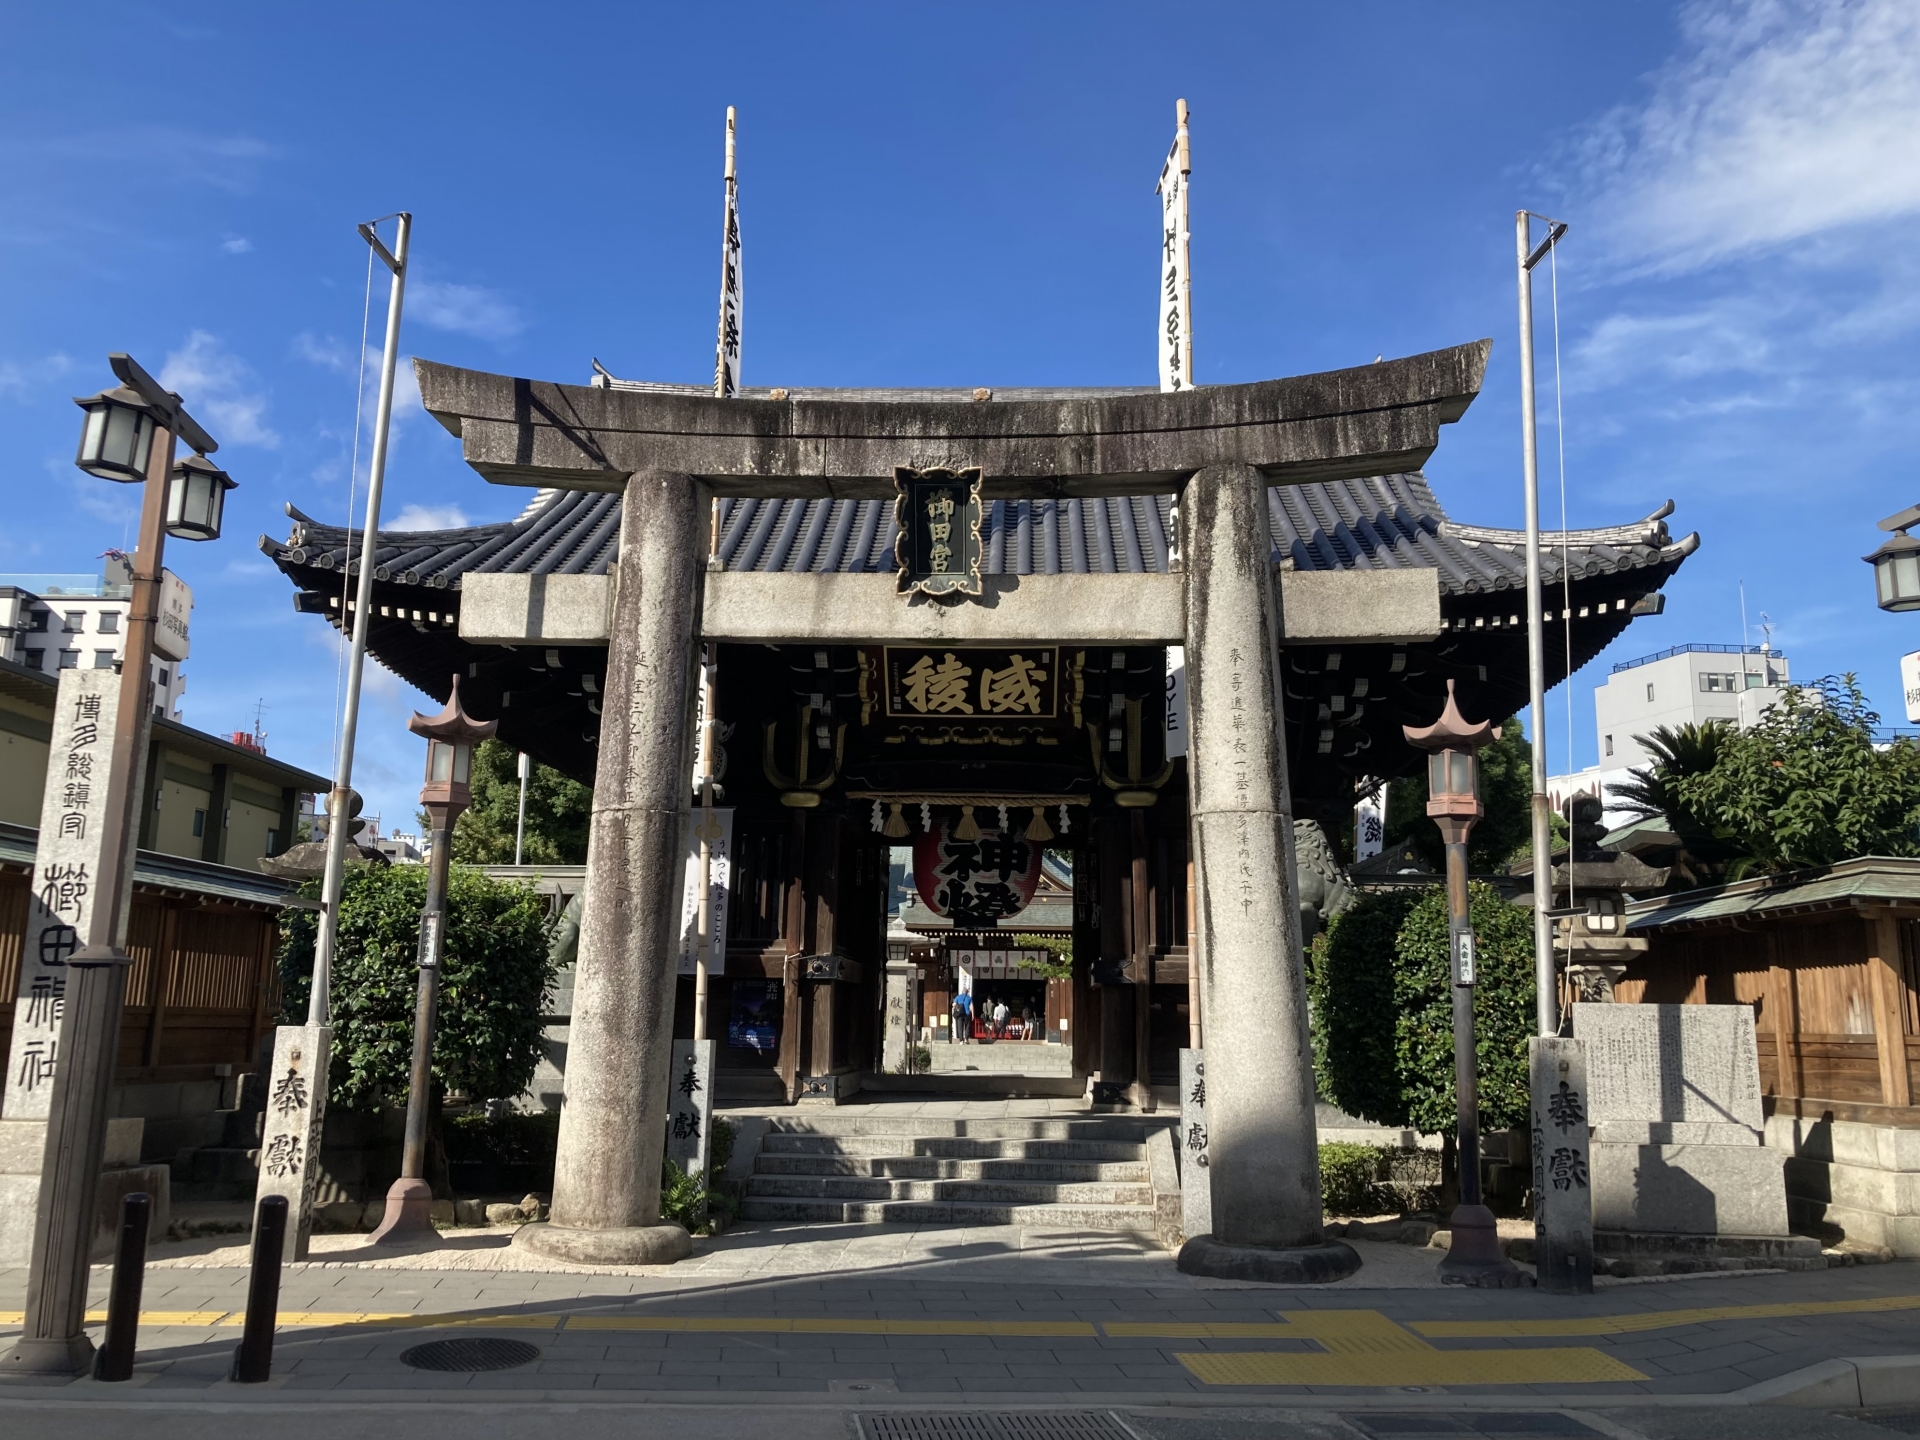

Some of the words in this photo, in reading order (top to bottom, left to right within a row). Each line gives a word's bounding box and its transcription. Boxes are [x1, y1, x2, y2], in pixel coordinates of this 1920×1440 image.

[713, 839, 727, 944] うけつぐ博多のこころ
